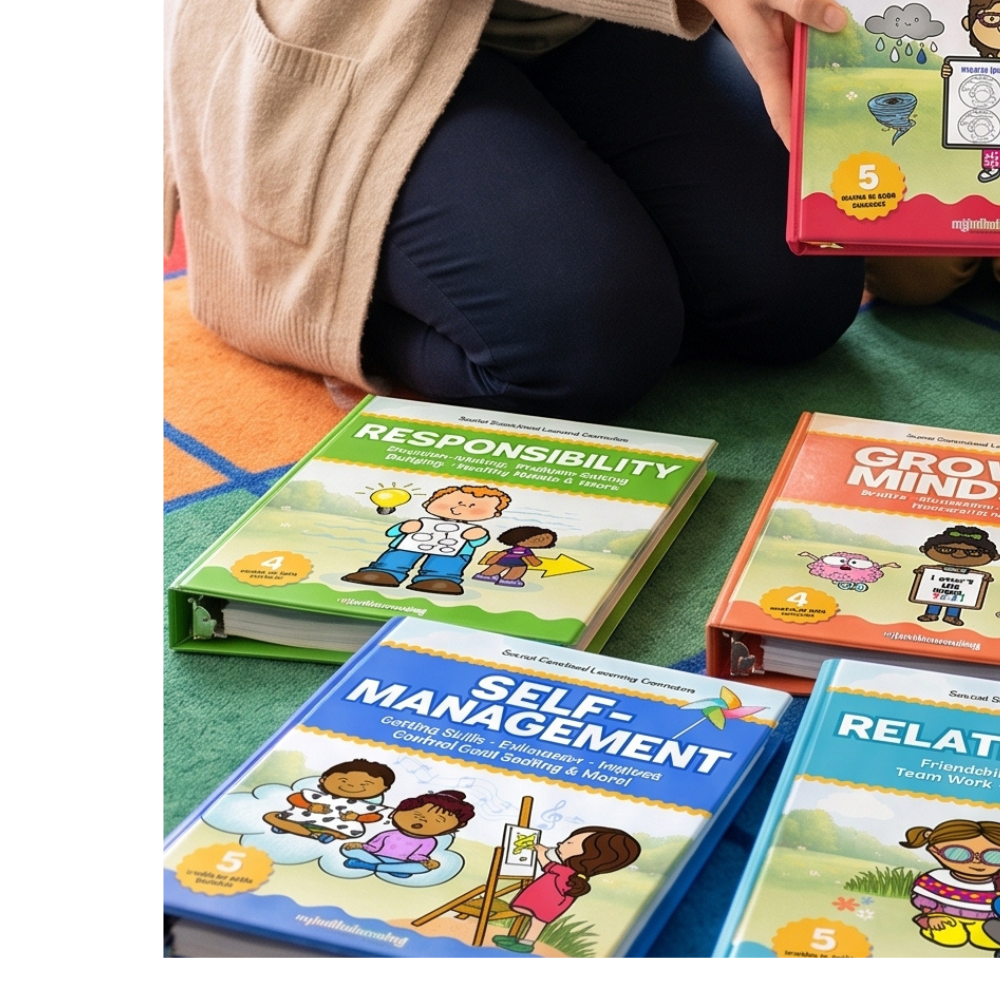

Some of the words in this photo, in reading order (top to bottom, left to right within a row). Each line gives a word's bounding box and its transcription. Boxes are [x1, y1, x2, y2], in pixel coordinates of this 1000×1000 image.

[858, 164, 879, 190] 5
[354, 422, 683, 479] RESPONSIBILITY
[260, 555, 285, 571] 4
[786, 591, 808, 607] 4
[471, 675, 633, 723] SELF-
[347, 678, 732, 775] MANAGEMENT
[565, 766, 579, 777] &
[896, 767, 941, 782] Team
[948, 774, 992, 790] Work
[216, 850, 246, 873] 5
[810, 927, 837, 951] 5
